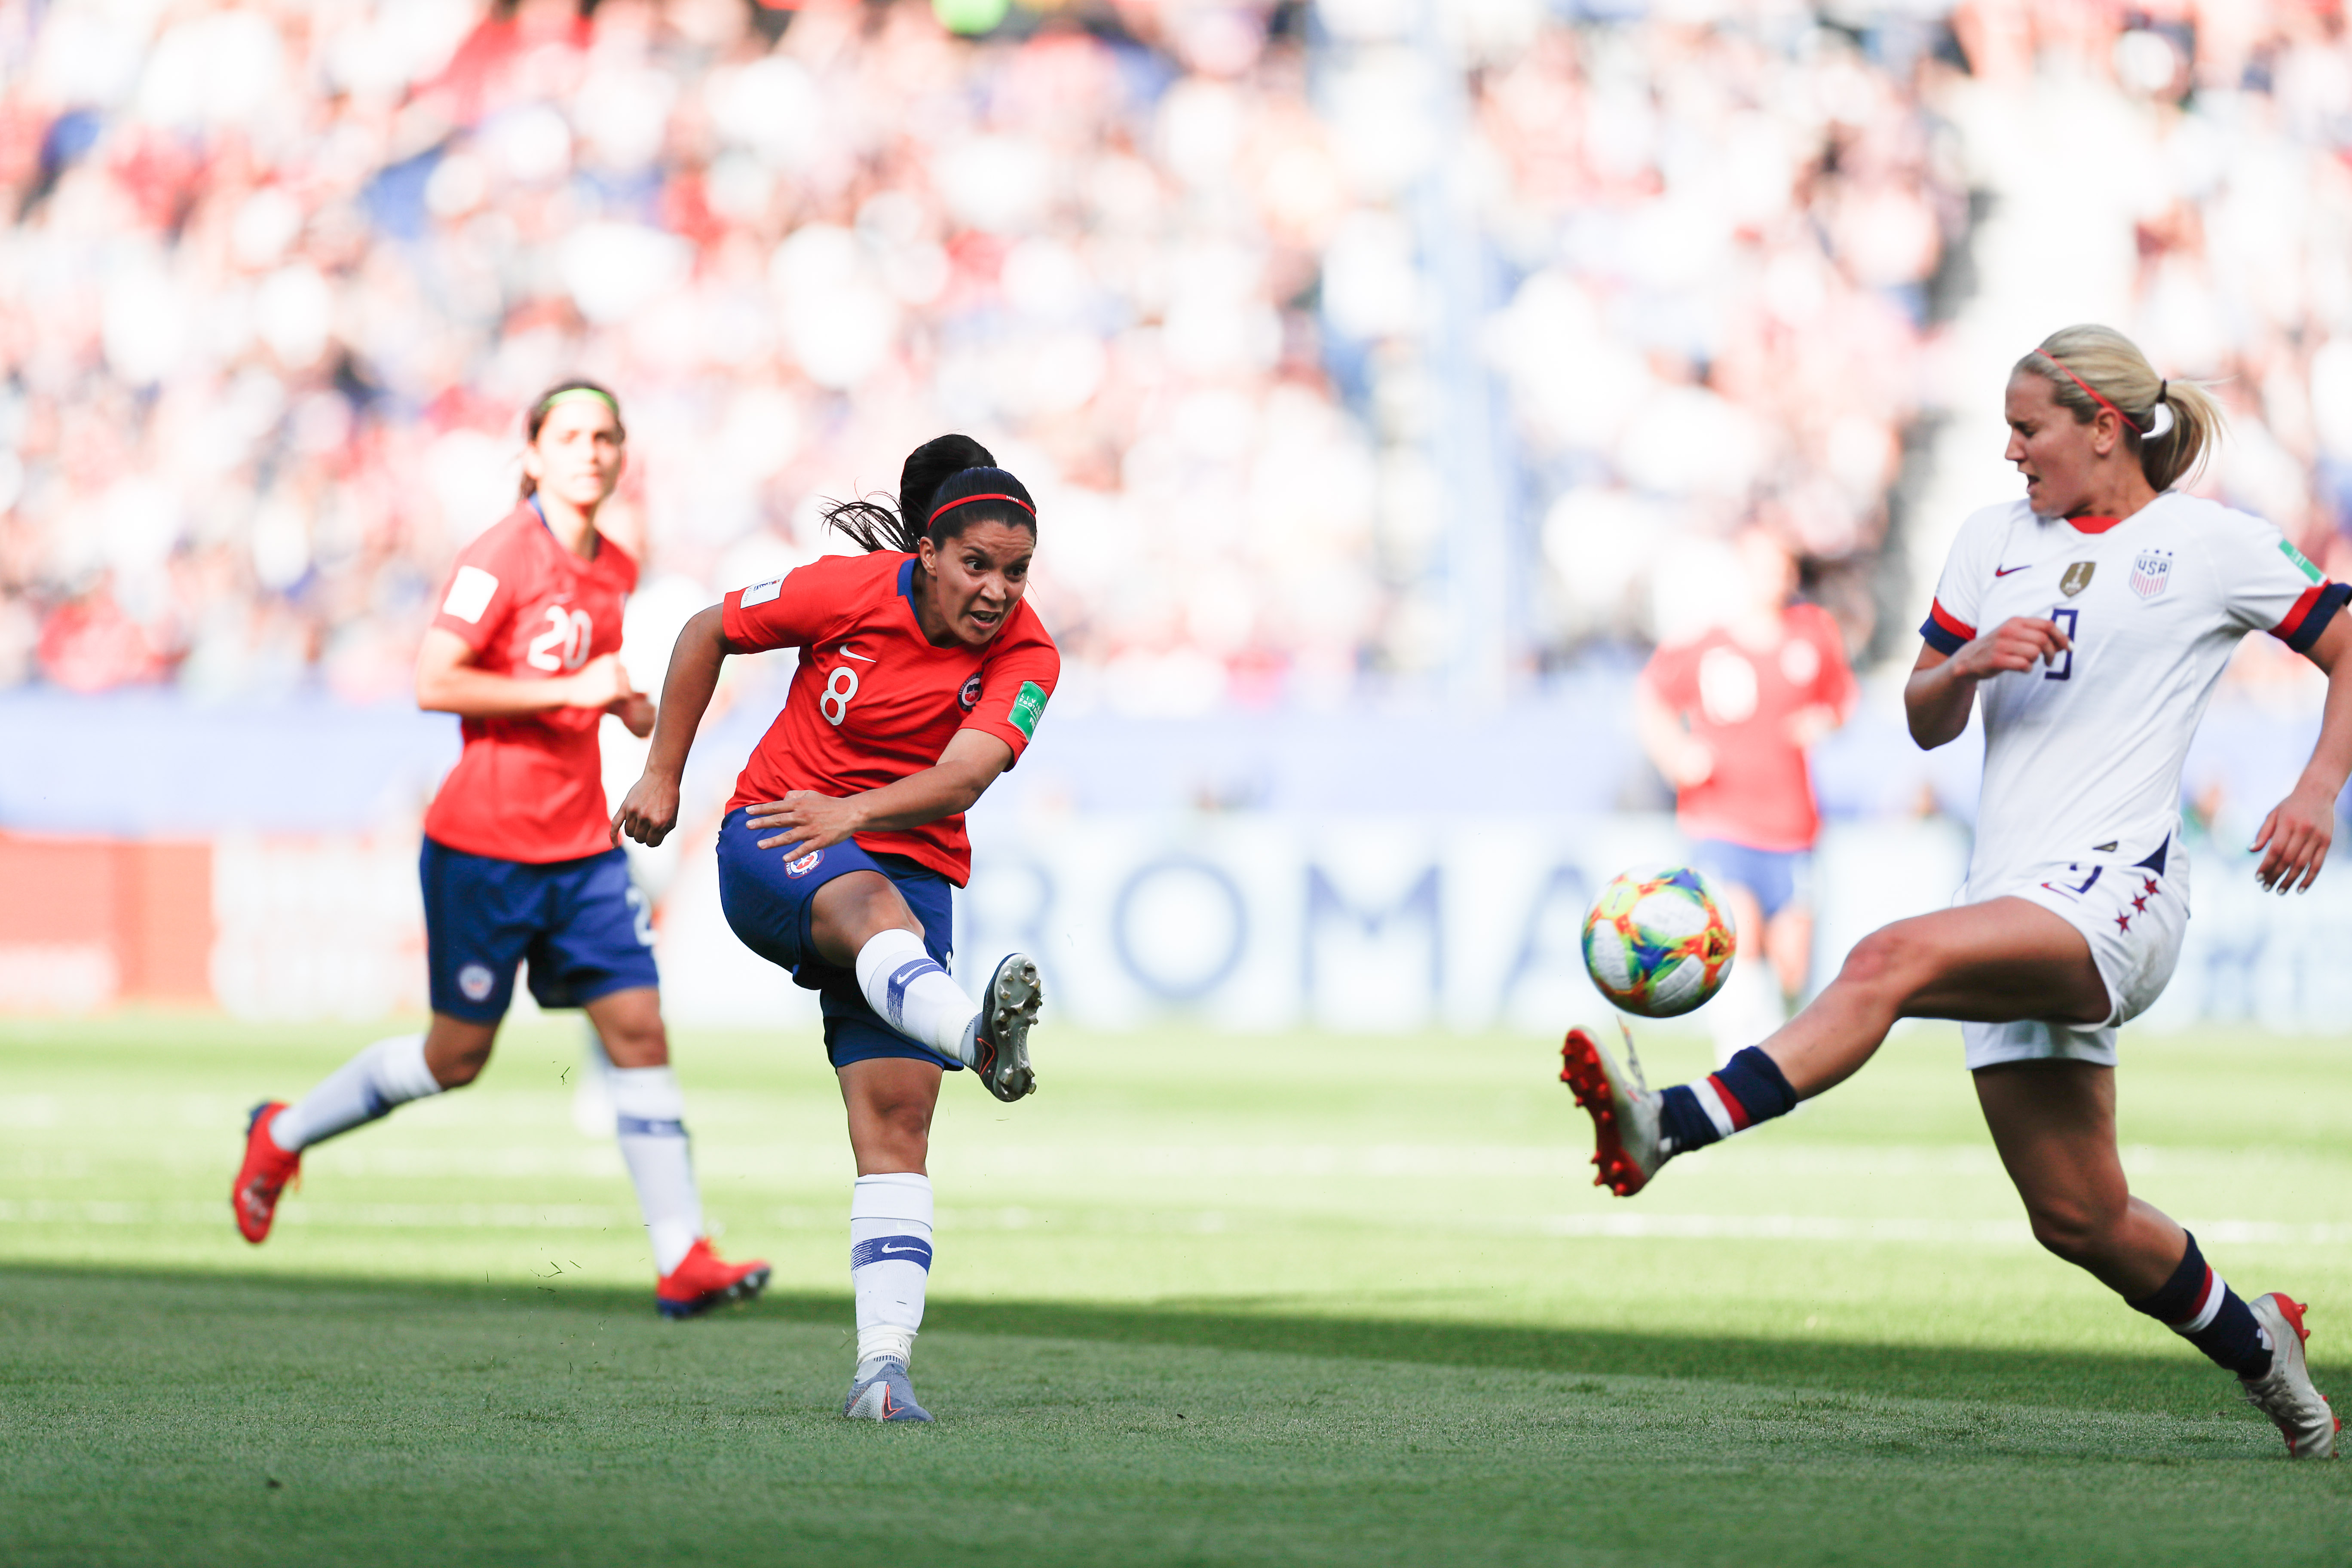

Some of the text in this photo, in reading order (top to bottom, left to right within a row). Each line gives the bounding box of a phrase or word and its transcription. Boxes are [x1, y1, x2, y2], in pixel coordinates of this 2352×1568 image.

[1006, 495, 1019, 503] NIKE
[2138, 559, 2167, 575] USA
[527, 605, 593, 672] 20
[820, 666, 859, 726] 8
[1021, 693, 1042, 715] LIVING
[625, 887, 659, 946] 2
